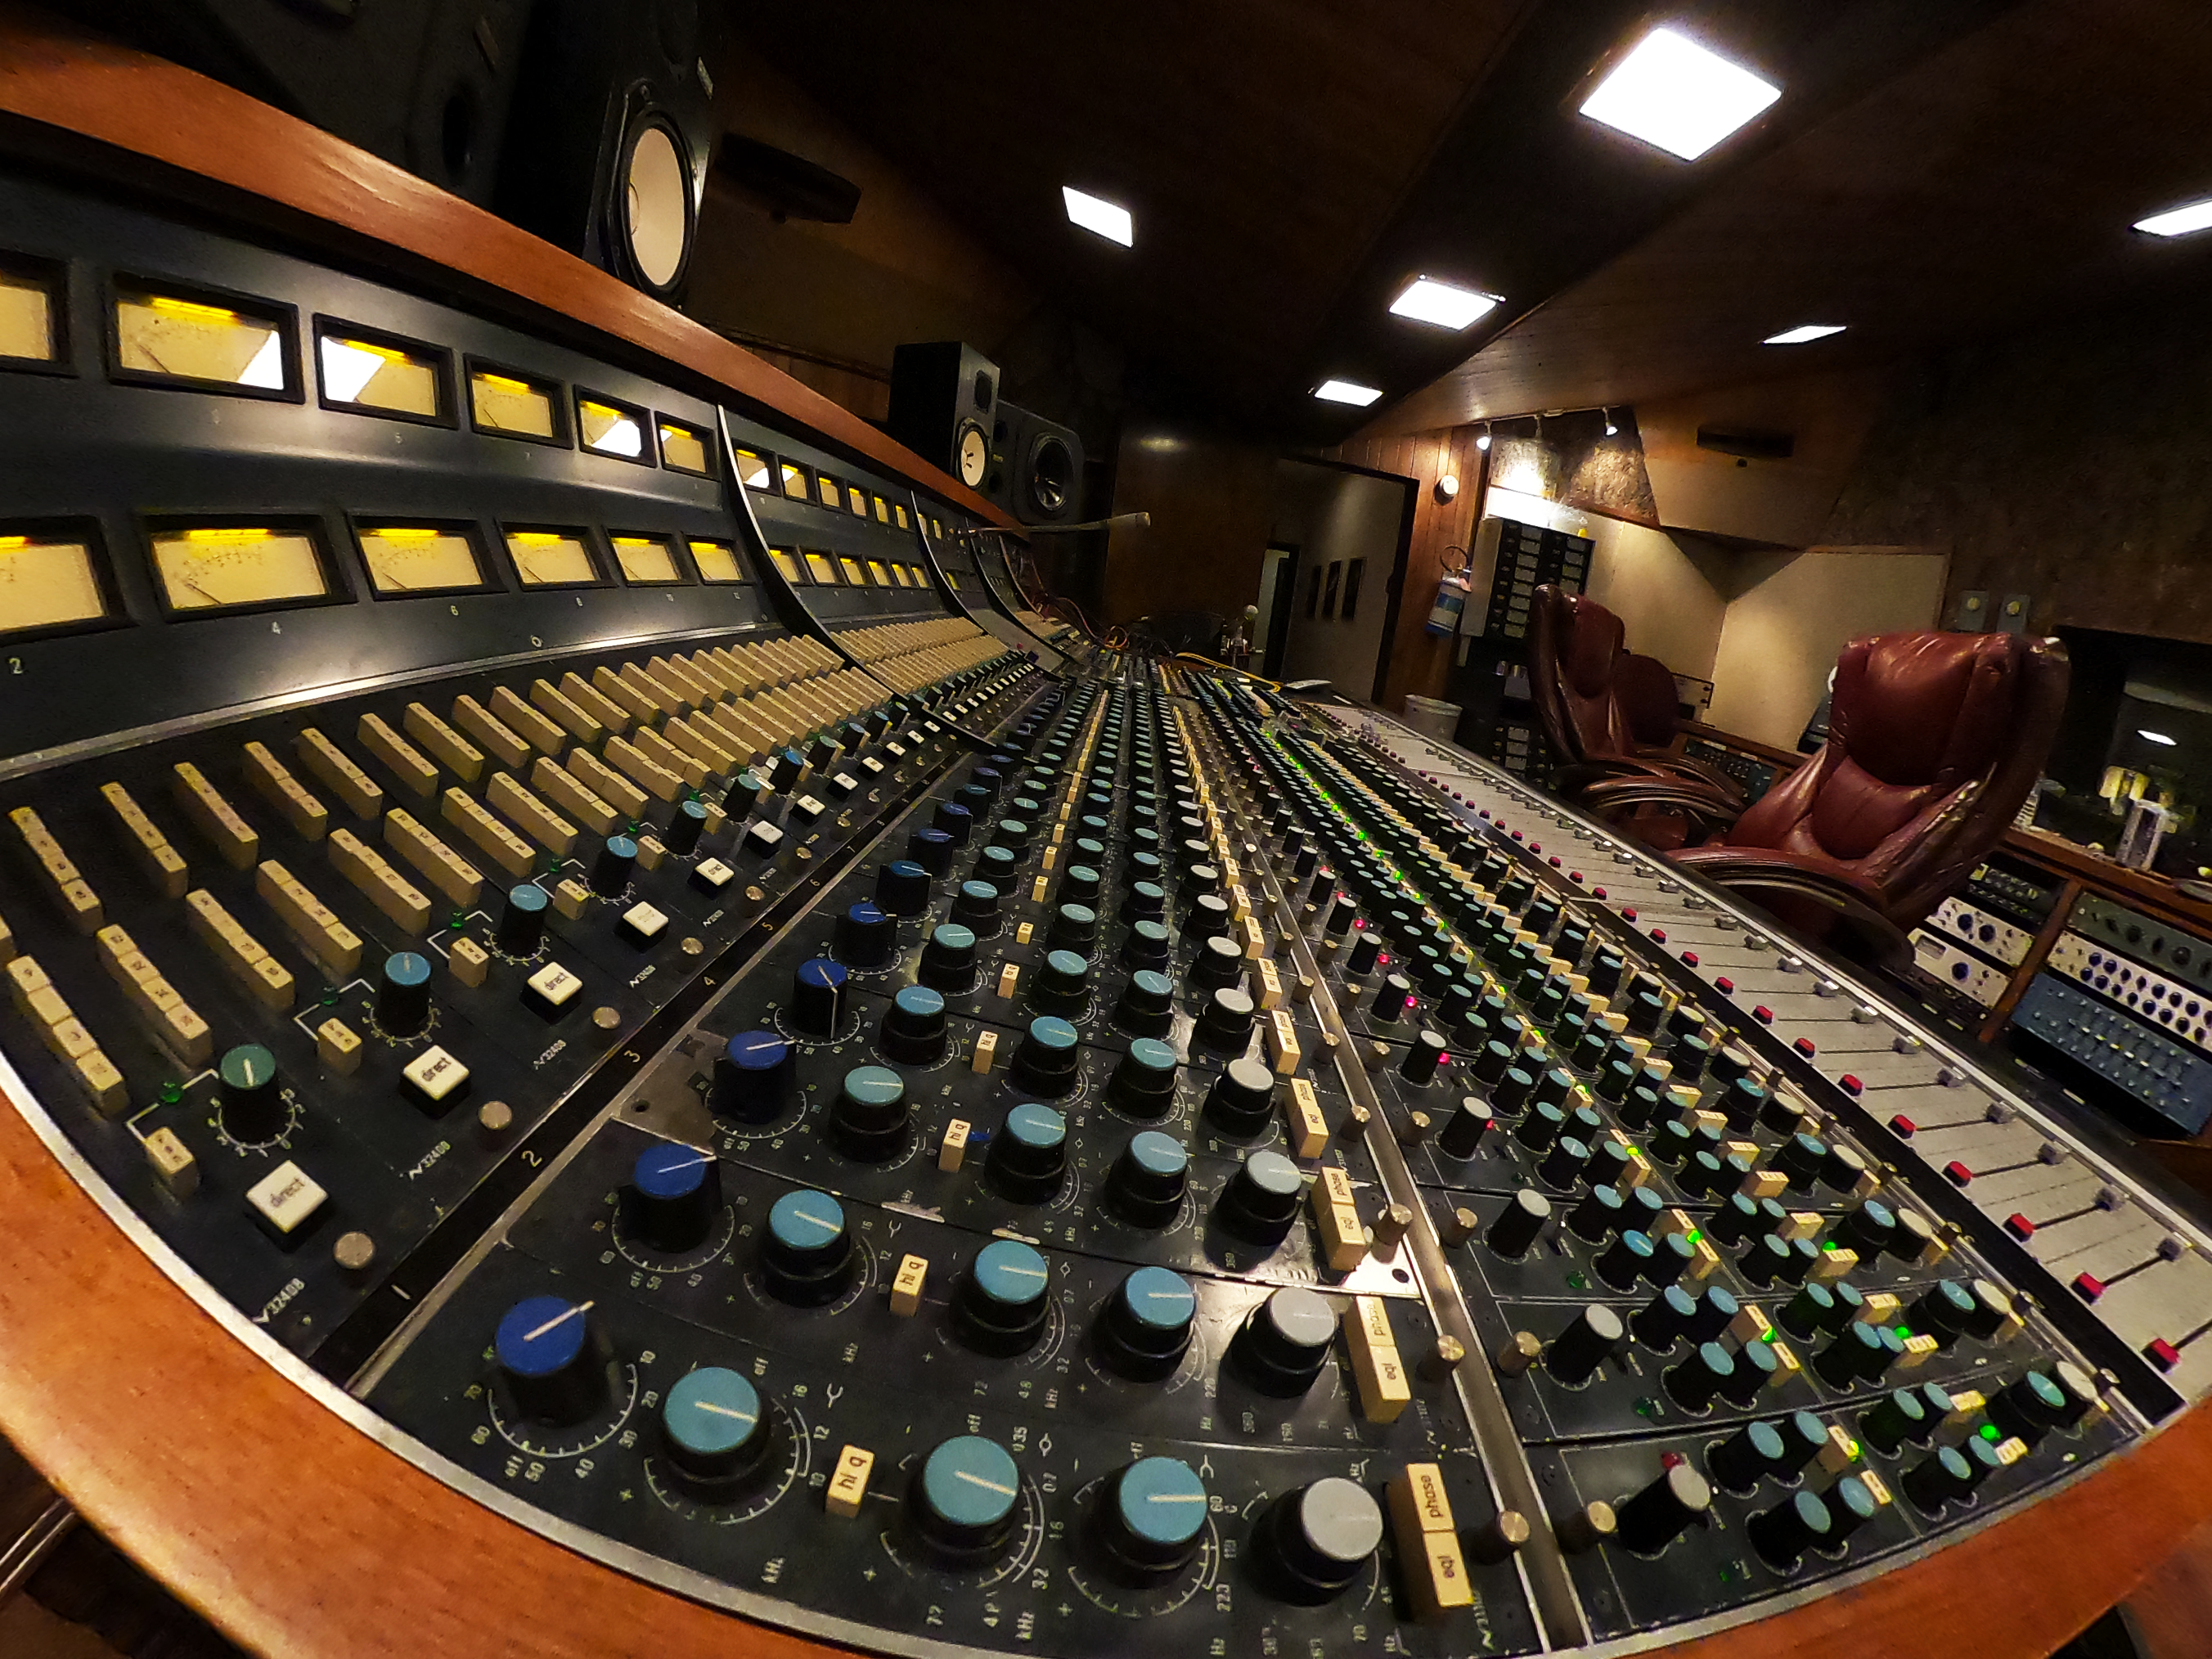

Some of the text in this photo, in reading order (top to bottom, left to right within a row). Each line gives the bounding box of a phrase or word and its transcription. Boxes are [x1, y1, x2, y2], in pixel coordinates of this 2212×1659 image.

[450, 605, 459, 616] 6
[9, 658, 23, 675] 2
[810, 879, 821, 887] 6
[762, 922, 774, 931] 5
[704, 976, 717, 987] 4
[624, 1050, 641, 1063] 3
[1297, 1082, 1313, 1102] phase
[521, 1149, 542, 1167] 2
[270, 1176, 305, 1207] direct
[1332, 1172, 1347, 1198] phase
[1073, 1205, 1084, 1217] 32
[1344, 1216, 1354, 1231] eql
[879, 1250, 892, 1261] 12
[899, 1261, 924, 1286] hi q
[1372, 1302, 1387, 1337] phase
[640, 1350, 655, 1364] 10
[753, 1357, 768, 1376] off
[1056, 1357, 1070, 1374] 32
[1385, 1362, 1397, 1381] eql
[641, 1390, 659, 1408] 20
[618, 1429, 638, 1450] 30
[813, 1425, 830, 1441] 12
[505, 1455, 524, 1477] off
[524, 1461, 546, 1482] 50
[575, 1458, 595, 1479] 40
[838, 1456, 867, 1490] hi q
[1209, 1495, 1224, 1513] 60
[1421, 1475, 1443, 1518] phase
[1437, 1555, 1455, 1579] eql
[1032, 1568, 1050, 1589] 32
[1216, 1584, 1232, 1612] 220
